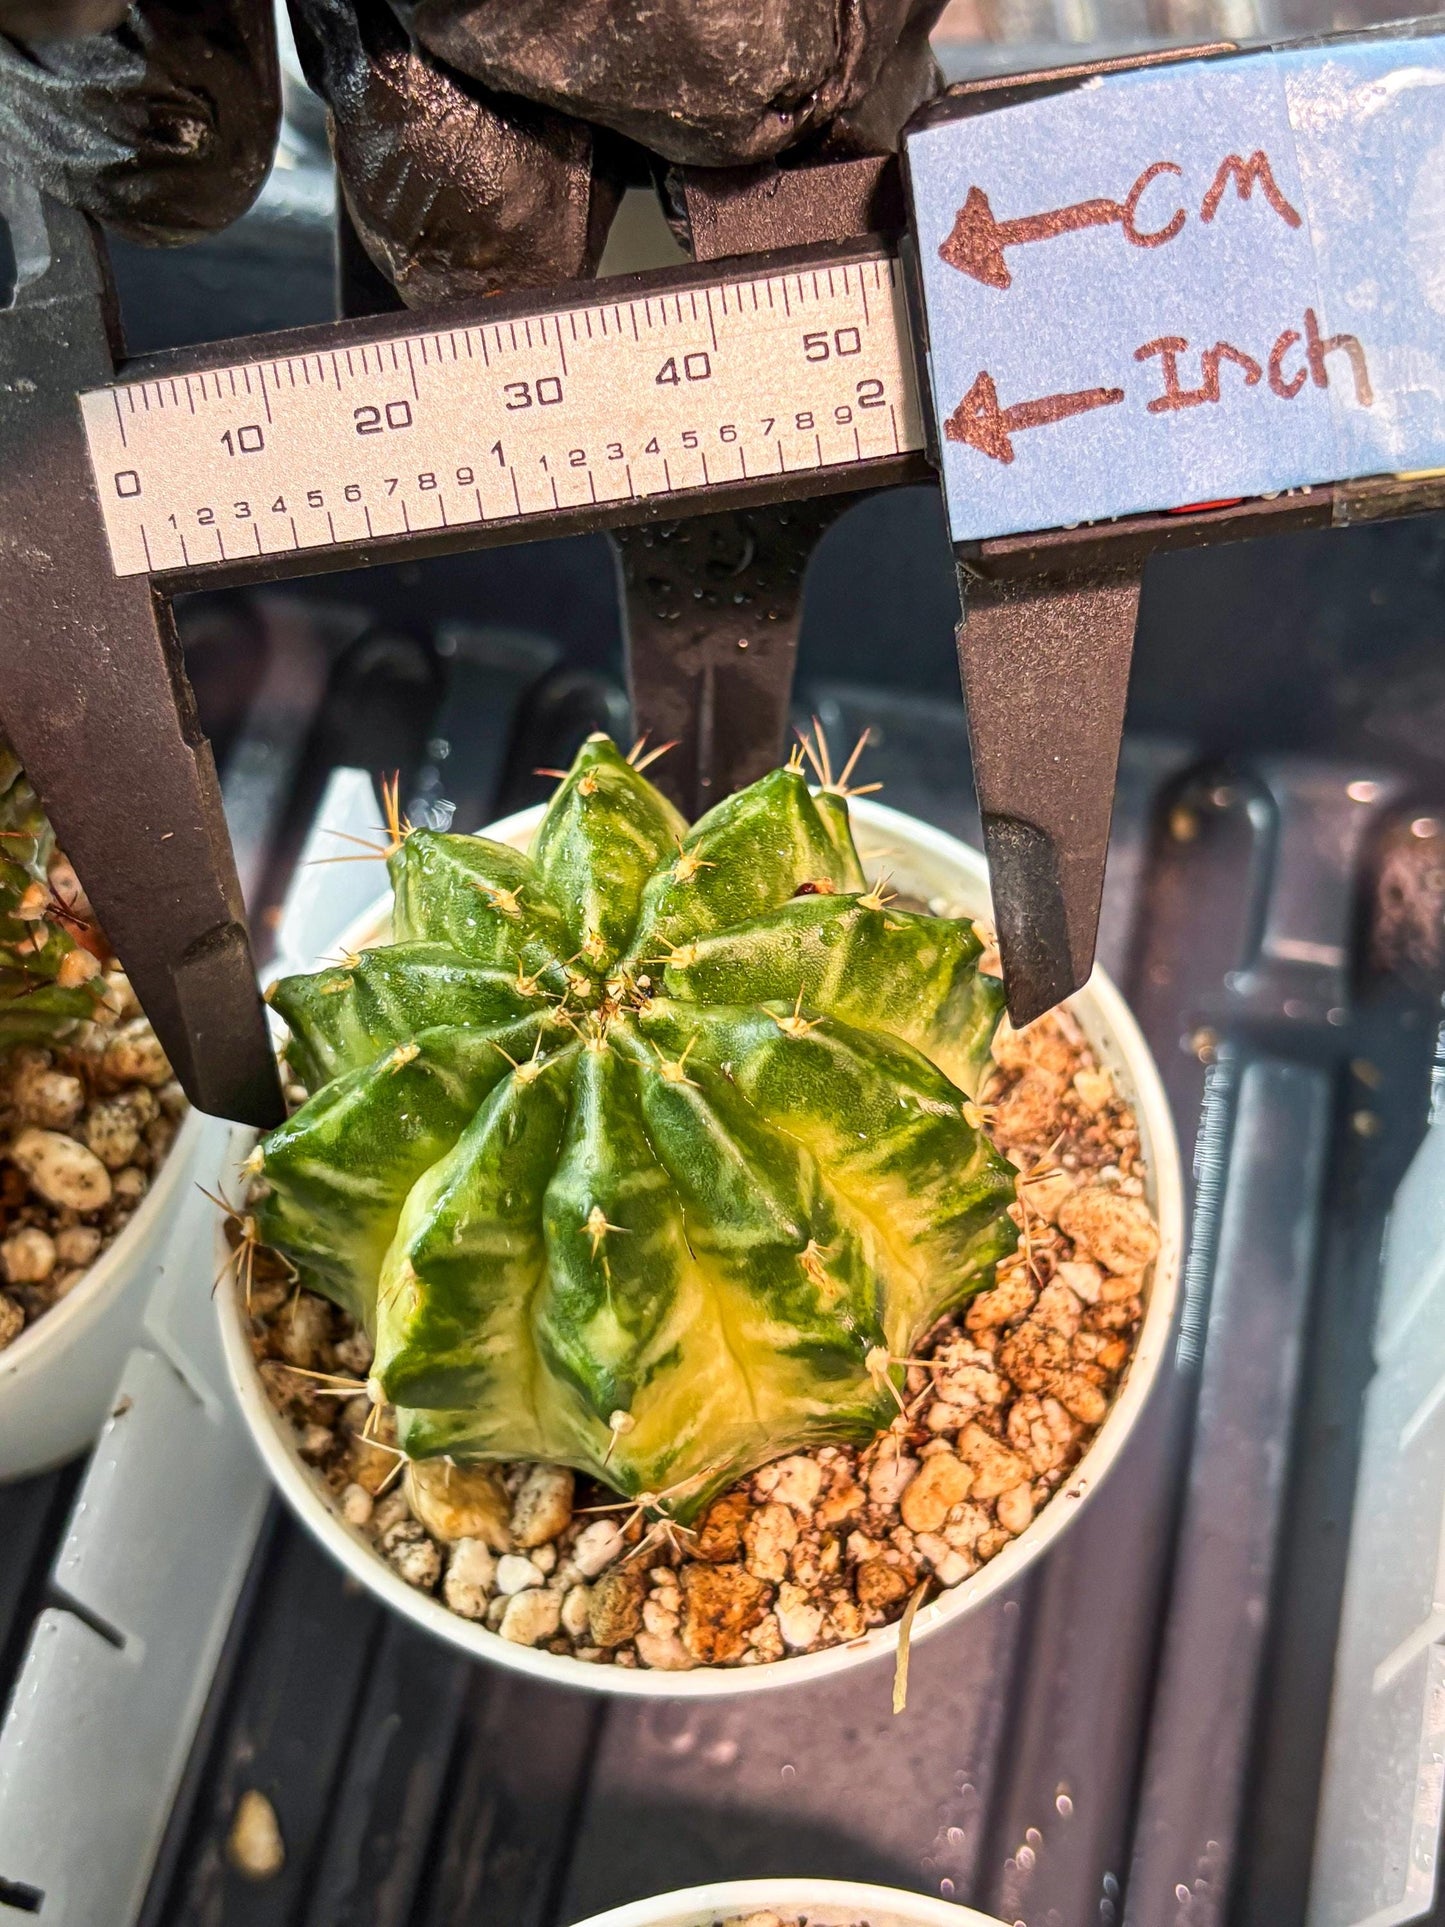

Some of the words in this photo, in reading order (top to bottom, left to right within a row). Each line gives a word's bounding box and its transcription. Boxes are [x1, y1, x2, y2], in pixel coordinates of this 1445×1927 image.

[114, 470, 142, 498] 0
[220, 424, 265, 457] 10
[353, 400, 414, 435] 20
[503, 376, 563, 412] 30
[654, 352, 711, 387] 40
[802, 326, 862, 363] 50
[1134, 307, 1374, 414] Inch
[167, 513, 178, 530] 1
[196, 507, 216, 526] 2
[233, 501, 252, 519] 3
[271, 496, 288, 514] 4
[306, 490, 324, 509] 5
[344, 484, 362, 503] 6
[384, 478, 399, 496] 7
[418, 472, 437, 490] 8
[456, 467, 474, 485] 9
[490, 441, 506, 467] 1
[539, 455, 548, 471] 1
[568, 449, 587, 467] 2
[607, 443, 624, 460] 3
[644, 436, 661, 455] 4
[681, 431, 699, 449] 5
[719, 425, 737, 443] 6
[760, 418, 776, 436] 7
[795, 412, 815, 430] 8
[834, 405, 853, 425] 9
[856, 379, 887, 409] 2
